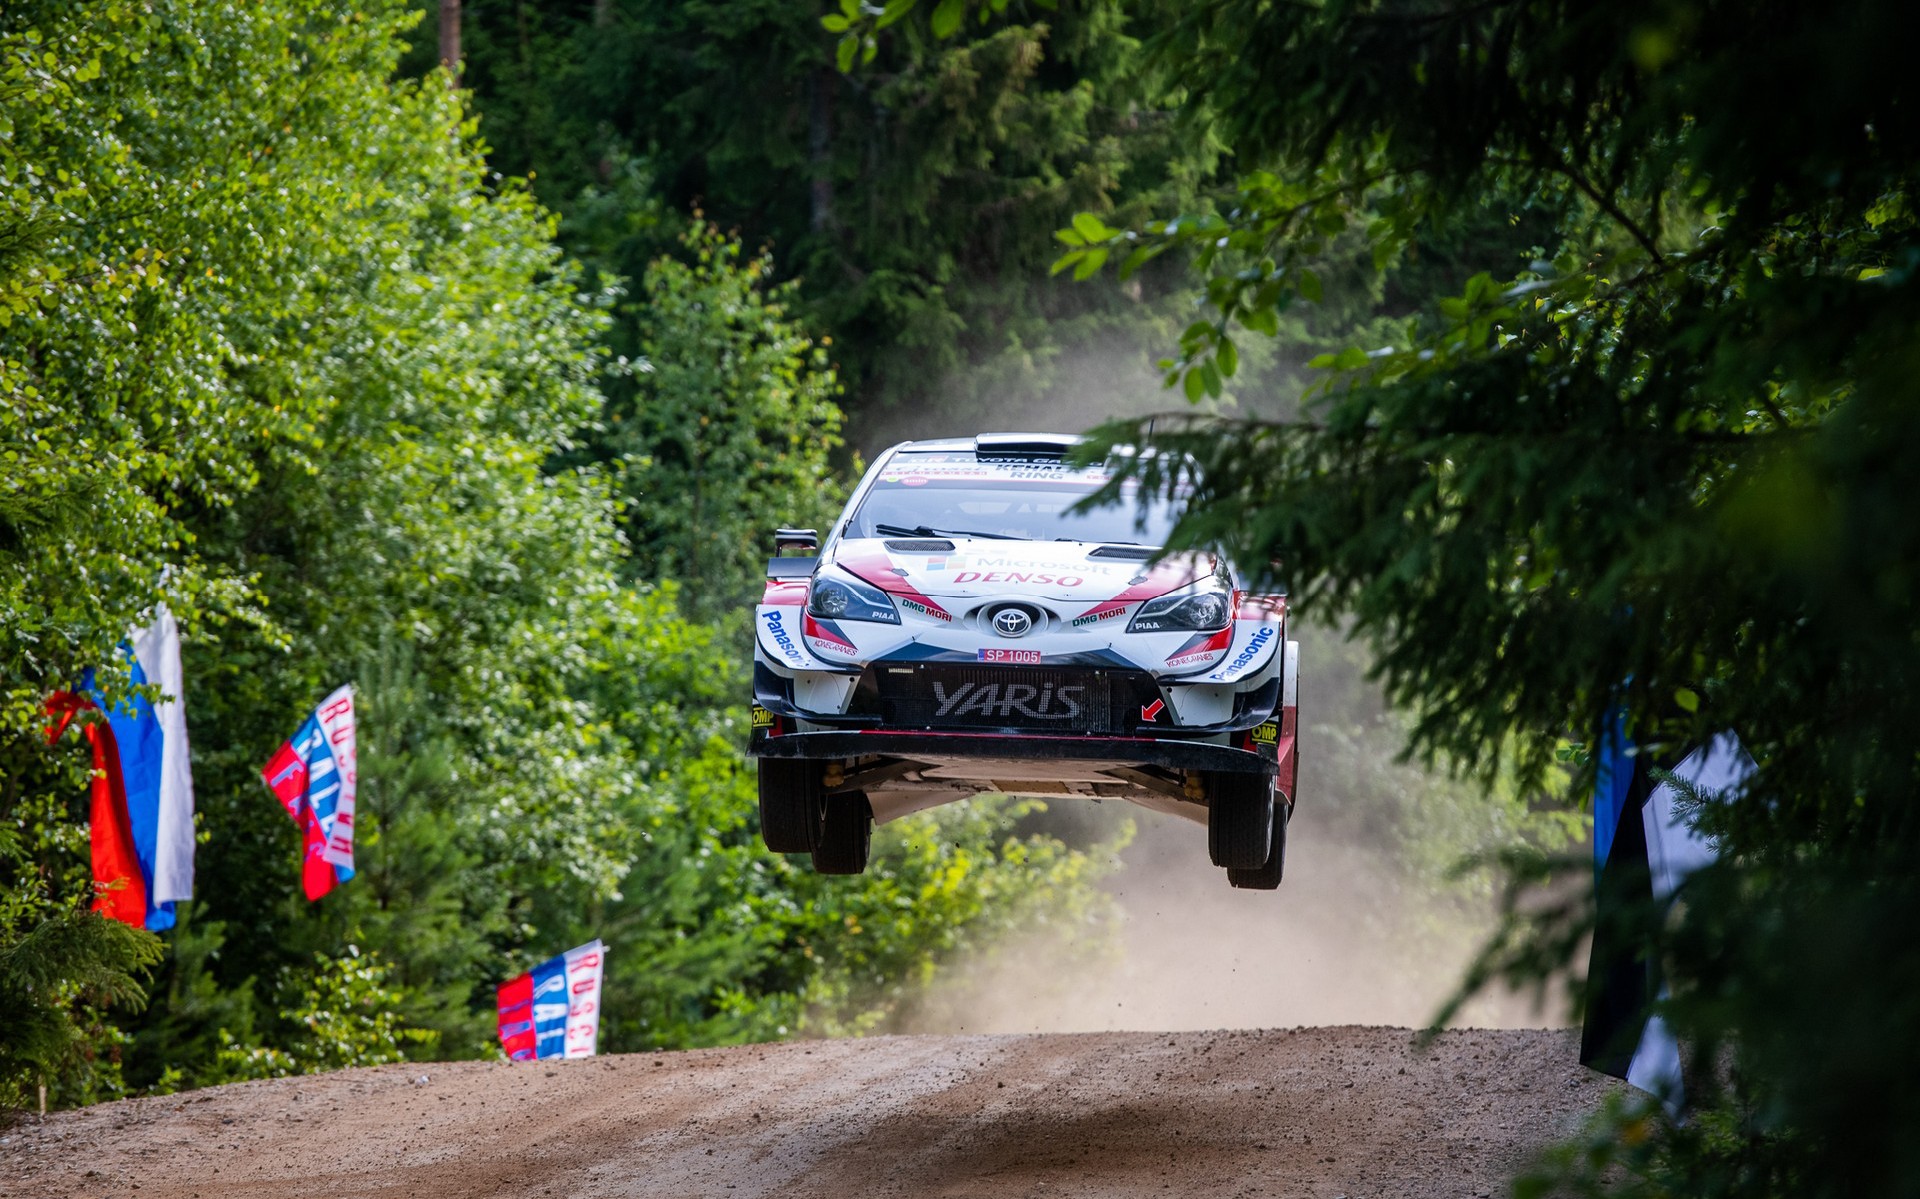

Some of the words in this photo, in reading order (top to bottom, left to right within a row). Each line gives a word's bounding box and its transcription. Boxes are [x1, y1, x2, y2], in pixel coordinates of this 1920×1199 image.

[1009, 471, 1064, 480] RING
[976, 557, 1112, 576] Microsoft
[953, 571, 1084, 587] DENSO
[871, 611, 895, 621] PIAA
[902, 598, 925, 613] DMG
[925, 607, 952, 623] MORI
[1072, 614, 1098, 628] DMG
[1098, 606, 1126, 621] MORI
[1135, 622, 1160, 630] PIAA
[762, 610, 809, 667] Panason
[986, 649, 1005, 661] SP
[1008, 650, 1039, 663] 1005
[1208, 626, 1274, 681] Panasonic
[752, 710, 774, 724] OMP
[1251, 725, 1277, 740] OMP
